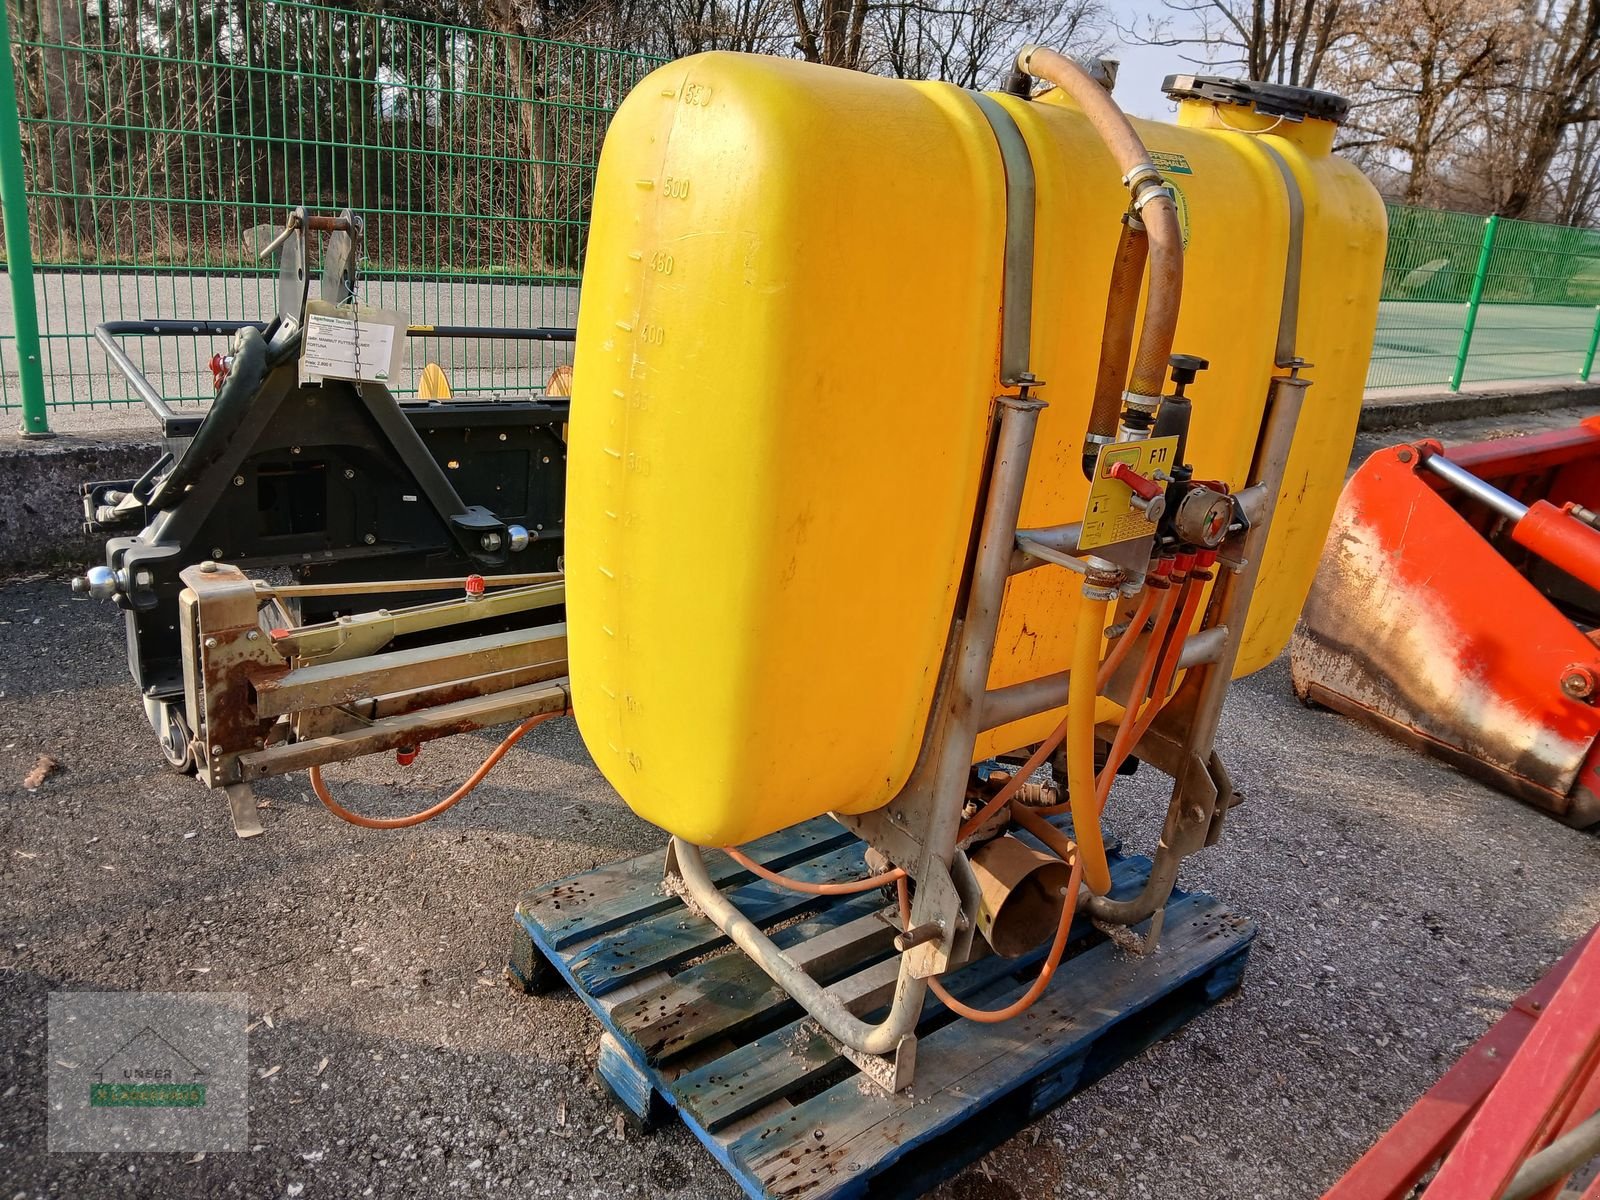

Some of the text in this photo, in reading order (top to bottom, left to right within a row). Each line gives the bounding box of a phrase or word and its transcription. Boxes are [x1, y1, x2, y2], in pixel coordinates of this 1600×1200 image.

[685, 83, 713, 107] 550
[663, 178, 689, 200] 500
[640, 324, 664, 346] 400
